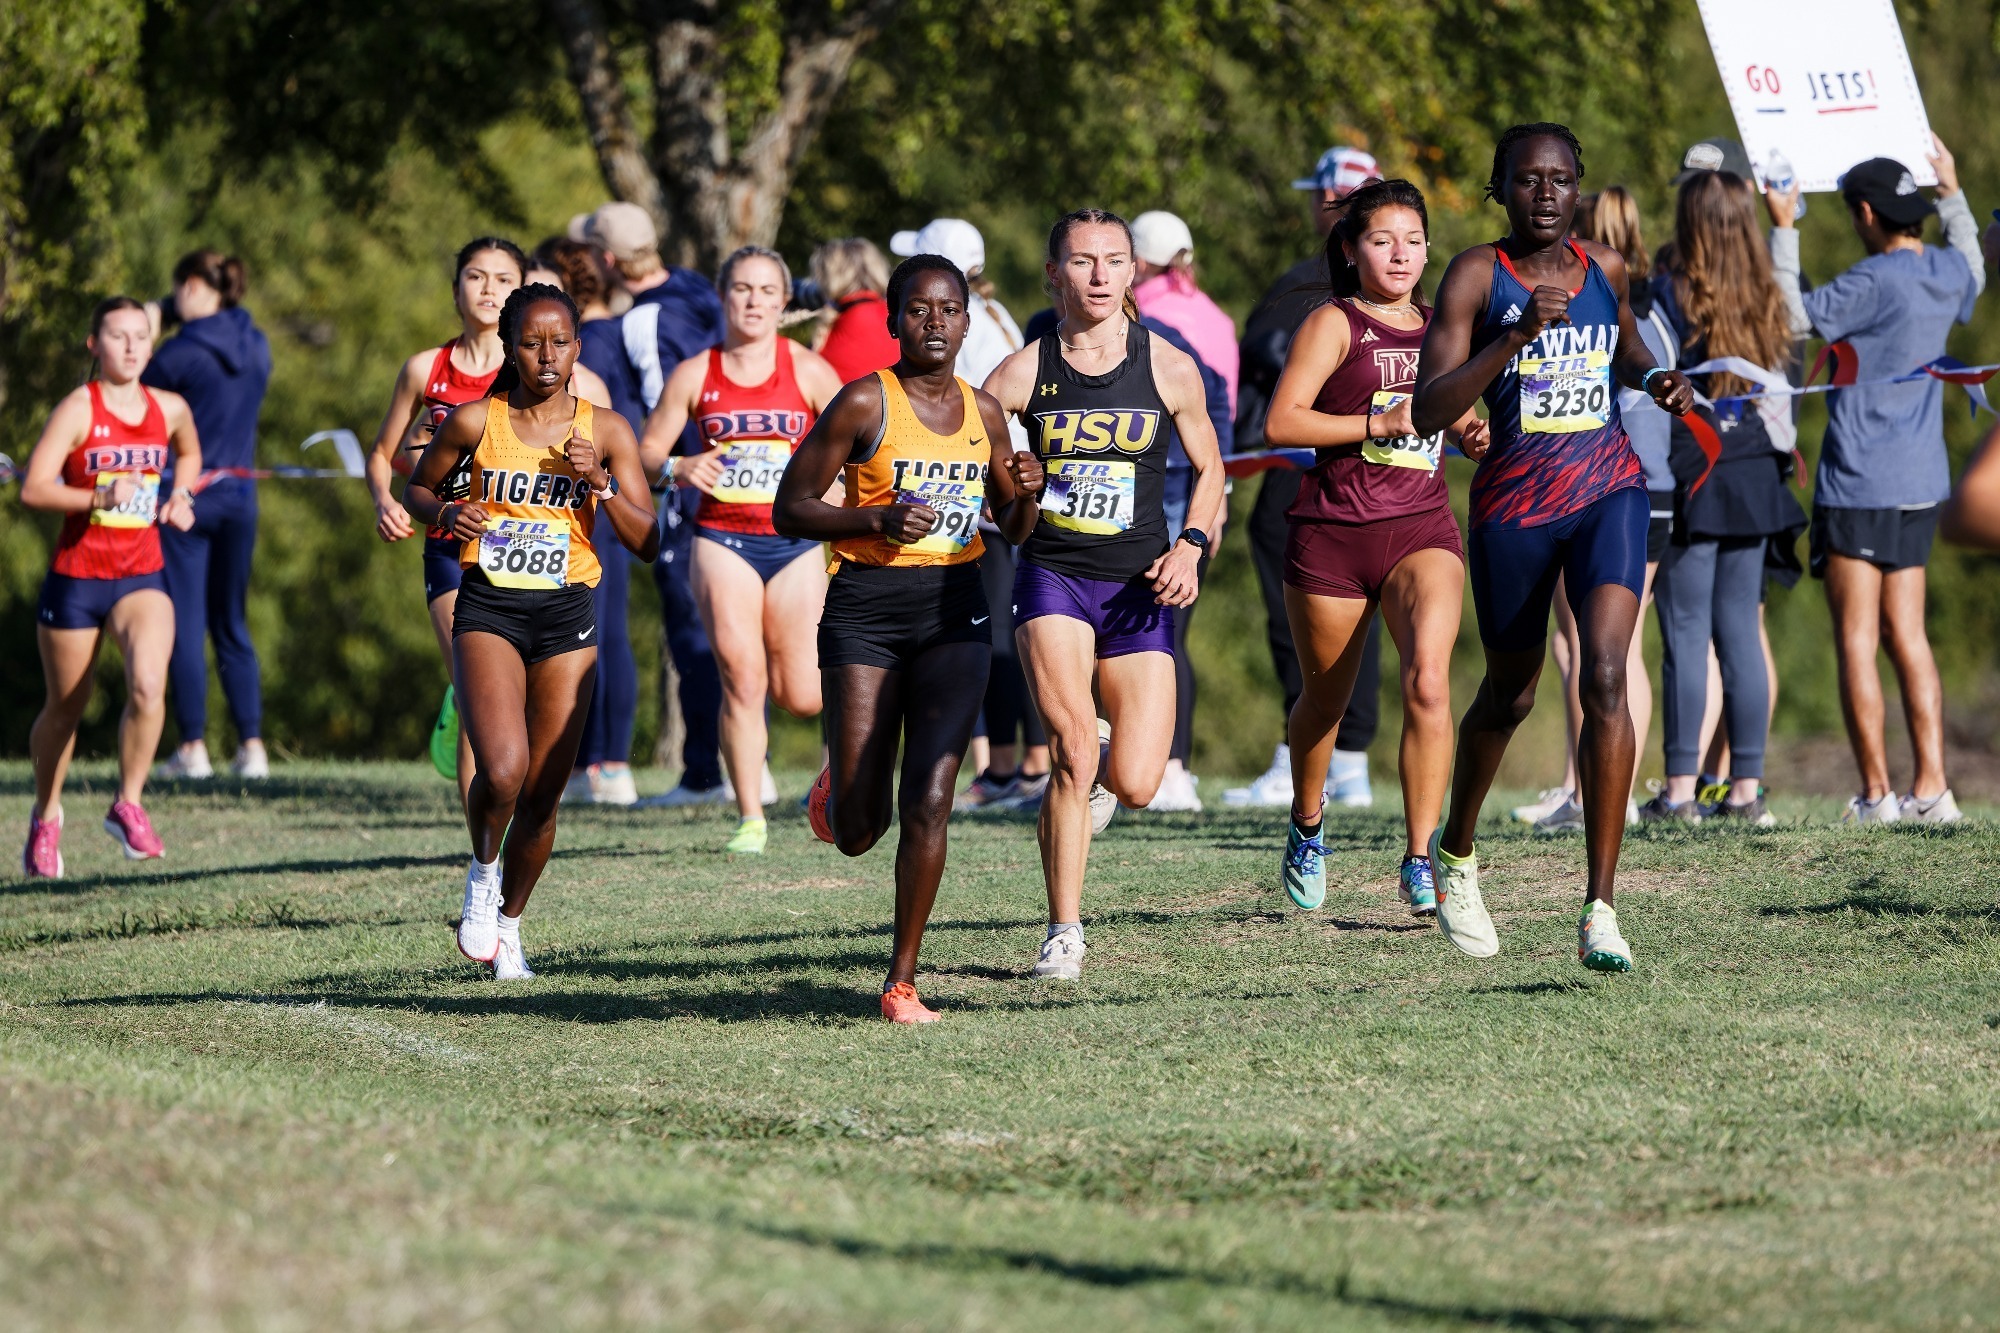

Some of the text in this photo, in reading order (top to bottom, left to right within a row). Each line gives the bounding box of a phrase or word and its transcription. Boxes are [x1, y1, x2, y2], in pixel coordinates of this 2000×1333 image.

[1746, 65, 1879, 100] GO JETS!
[1504, 324, 1620, 378] EWMAN
[1537, 357, 1588, 374] FTR
[1533, 384, 1605, 419] 3230
[699, 405, 808, 440] DBU
[1037, 410, 1159, 456] HSU
[1060, 463, 1110, 476] FTR
[480, 468, 592, 510] TIGERS
[917, 481, 966, 495] FTR
[1060, 491, 1121, 519] 3131
[498, 520, 549, 534] FTR
[926, 510, 975, 538] 091
[486, 546, 566, 575] 3088
